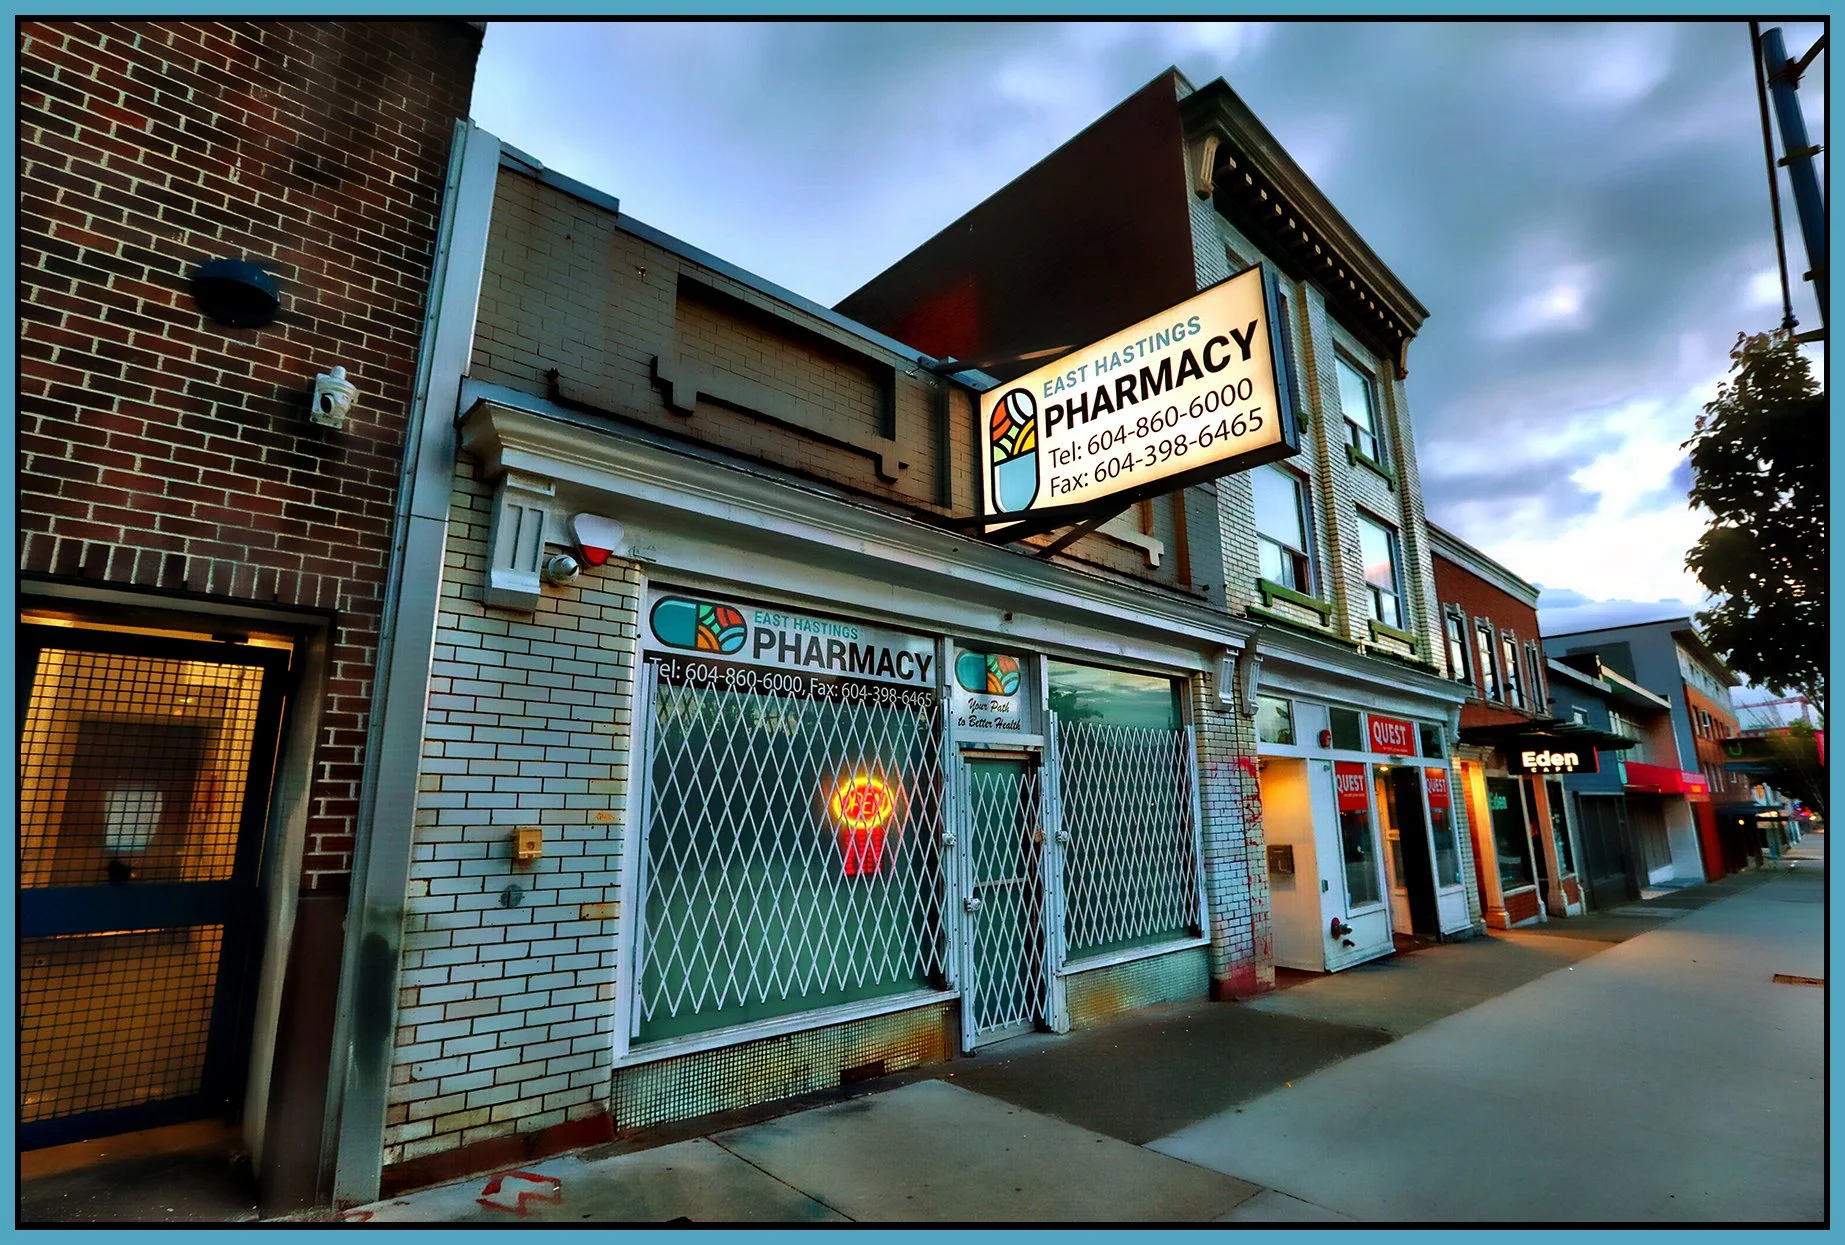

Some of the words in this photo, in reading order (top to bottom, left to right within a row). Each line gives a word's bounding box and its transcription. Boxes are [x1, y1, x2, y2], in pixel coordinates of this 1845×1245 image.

[1043, 364, 1088, 399] EAST
[1094, 315, 1202, 377] HASTINGS
[1044, 318, 1258, 439] PHARMACY
[1048, 440, 1082, 469] Tel:
[1087, 377, 1254, 456] 604-860-6000
[1050, 471, 1089, 498] Fax:
[1094, 406, 1264, 482] 604-398-6465
[754, 610, 789, 628] EAST
[793, 617, 859, 640] HASTINGS
[753, 626, 933, 683] PHARMACY
[649, 657, 681, 680] Tel:
[810, 677, 839, 697] Fax:
[841, 683, 932, 708] 604-398-6465
[968, 697, 988, 714] Your
[990, 700, 1010, 713] Path
[957, 716, 966, 727] to
[968, 714, 993, 729] Better
[994, 716, 1022, 731] Health
[1373, 721, 1407, 746] QUEST
[1521, 750, 1580, 768] Eden
[1336, 774, 1364, 794] QUEST
[1426, 778, 1447, 794] QUEST
